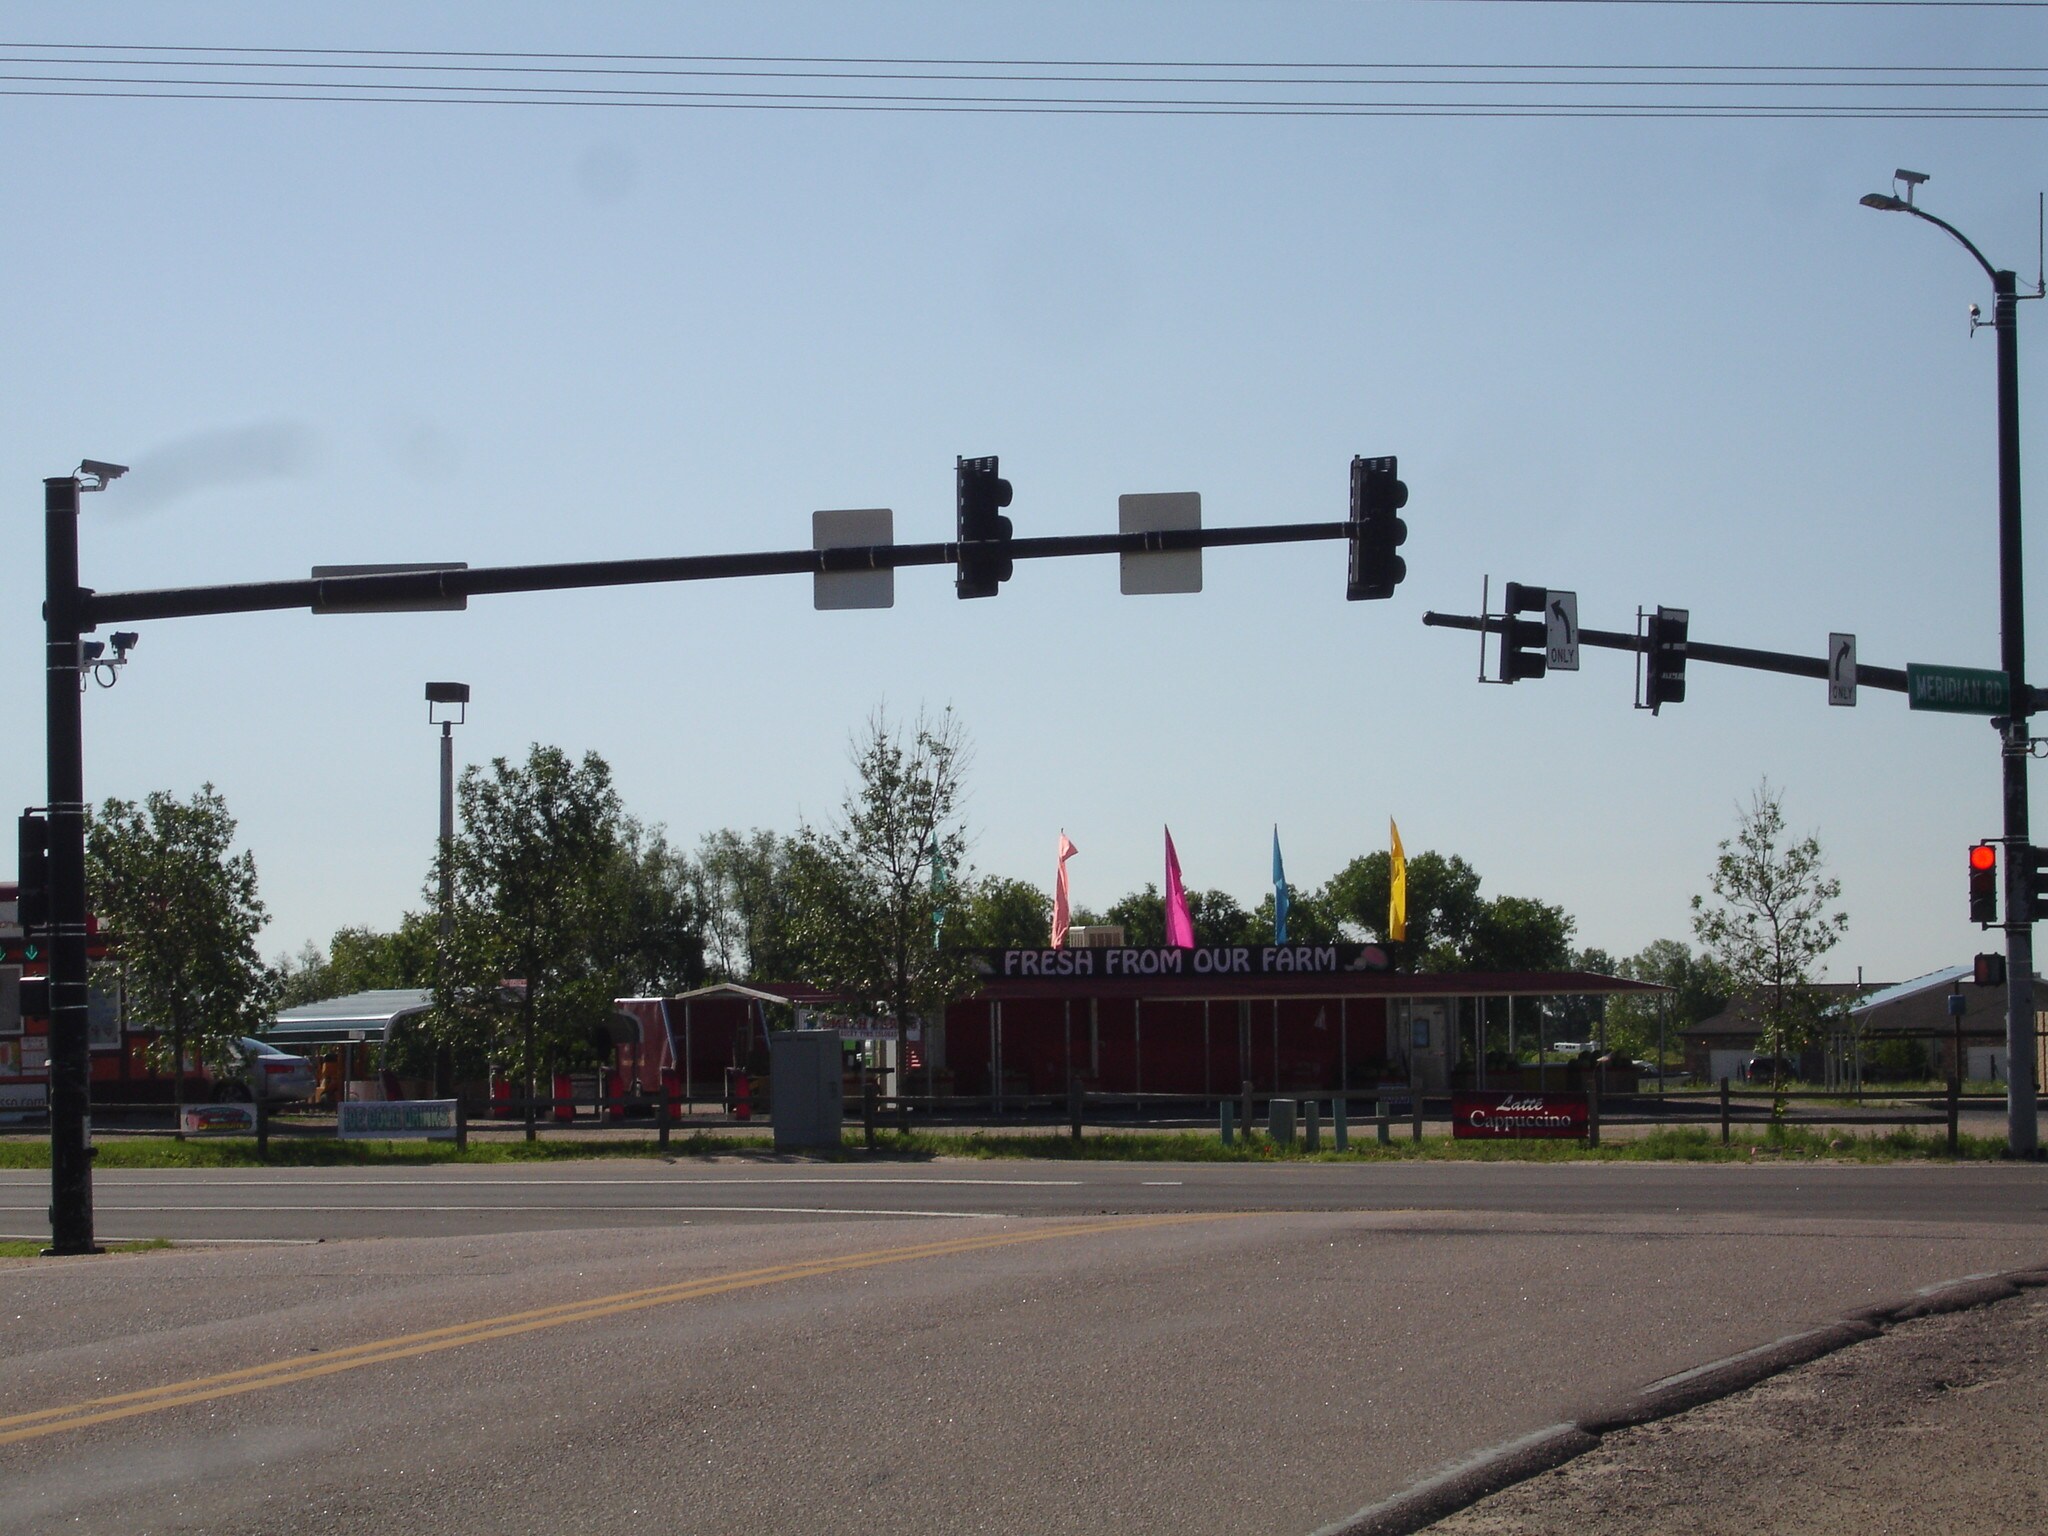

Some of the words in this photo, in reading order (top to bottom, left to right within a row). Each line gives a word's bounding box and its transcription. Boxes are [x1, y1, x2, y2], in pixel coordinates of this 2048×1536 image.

[1551, 648, 1574, 663] ONLY
[1832, 685, 1853, 699] ONLY
[1916, 674, 1980, 703] MERIDIAN
[1985, 681, 2003, 705] RD
[1005, 951, 1093, 976] FRESH
[1106, 950, 1182, 974] FROM
[1193, 948, 1250, 973] OUR
[1262, 947, 1336, 972] FARM
[1470, 1109, 1571, 1132] Cappuccino
